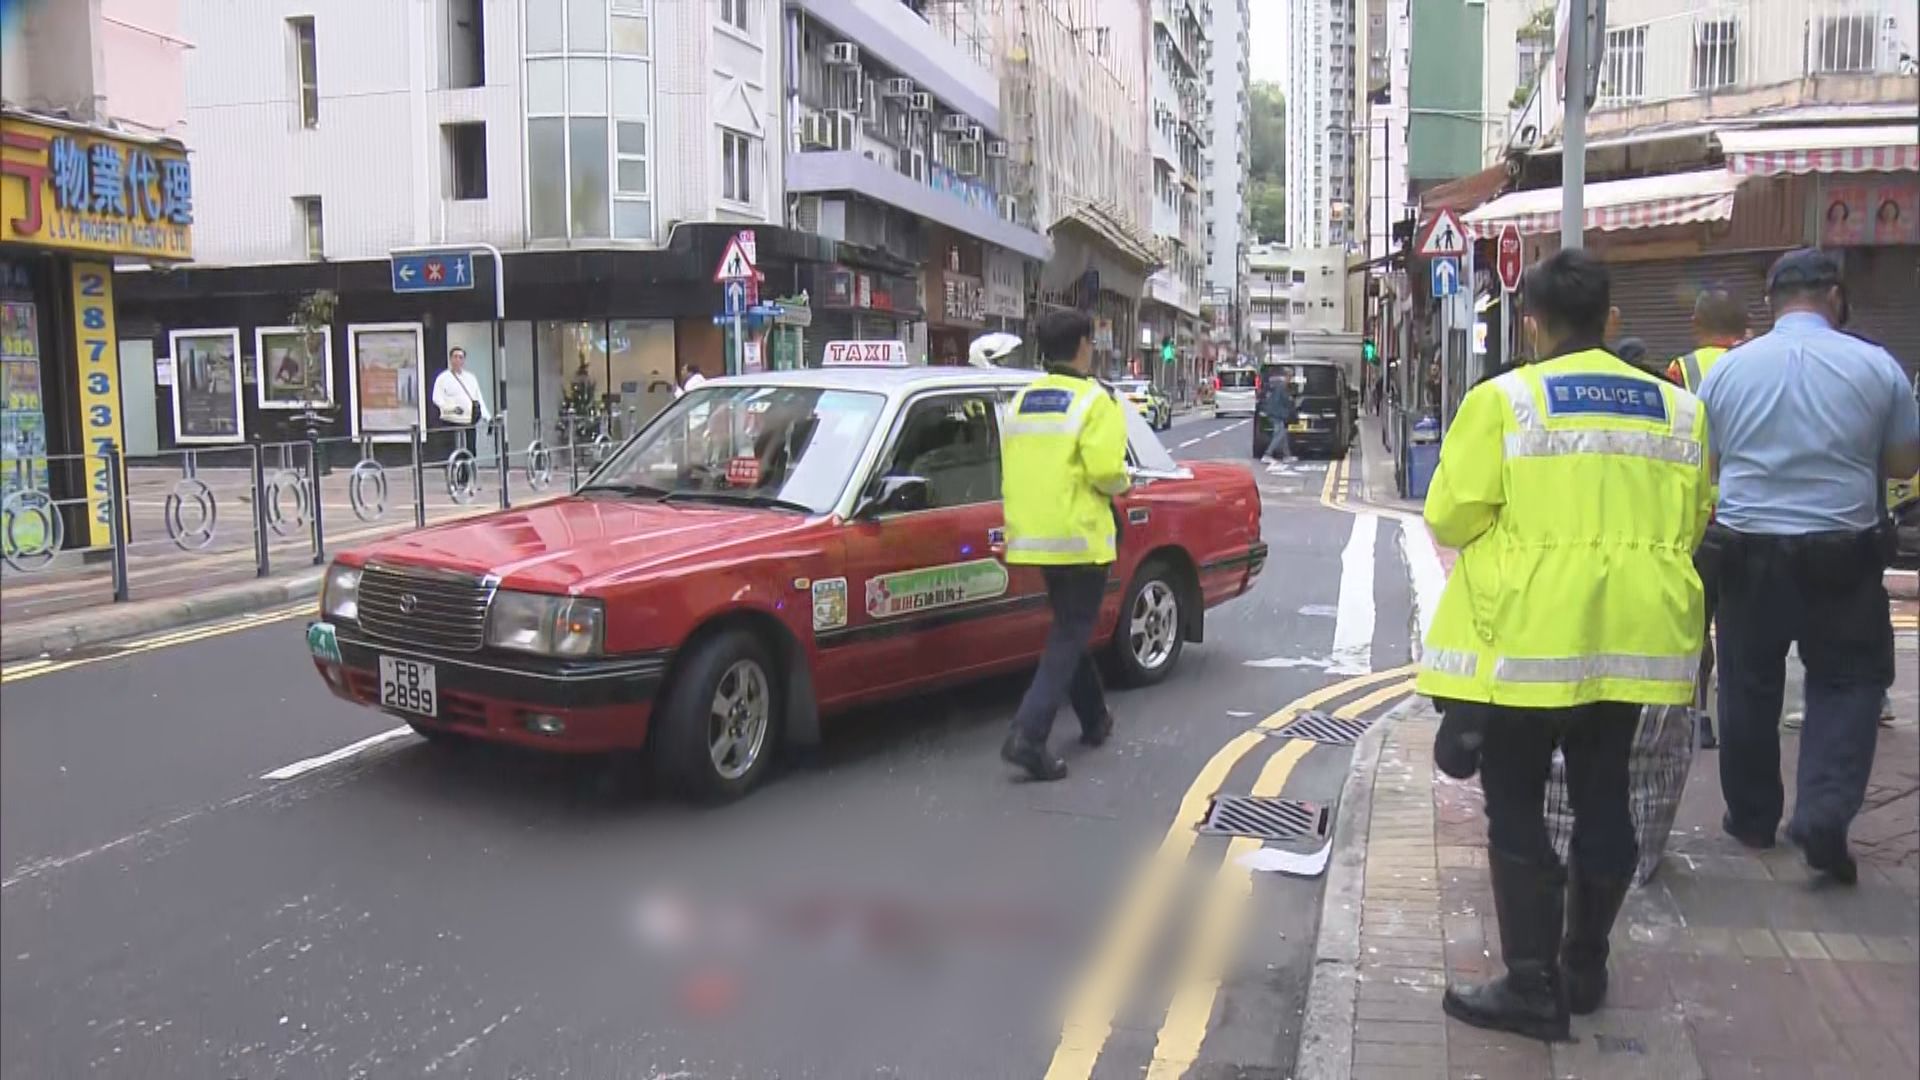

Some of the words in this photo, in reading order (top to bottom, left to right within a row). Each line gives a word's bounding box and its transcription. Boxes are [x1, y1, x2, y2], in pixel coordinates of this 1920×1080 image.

[54, 136, 193, 224] 物業代理
[1503, 239, 1519, 253] STOP
[830, 343, 891, 361] TAXI
[1574, 386, 1641, 405] POLICE
[395, 660, 420, 688] FB
[384, 682, 433, 713] 2899
